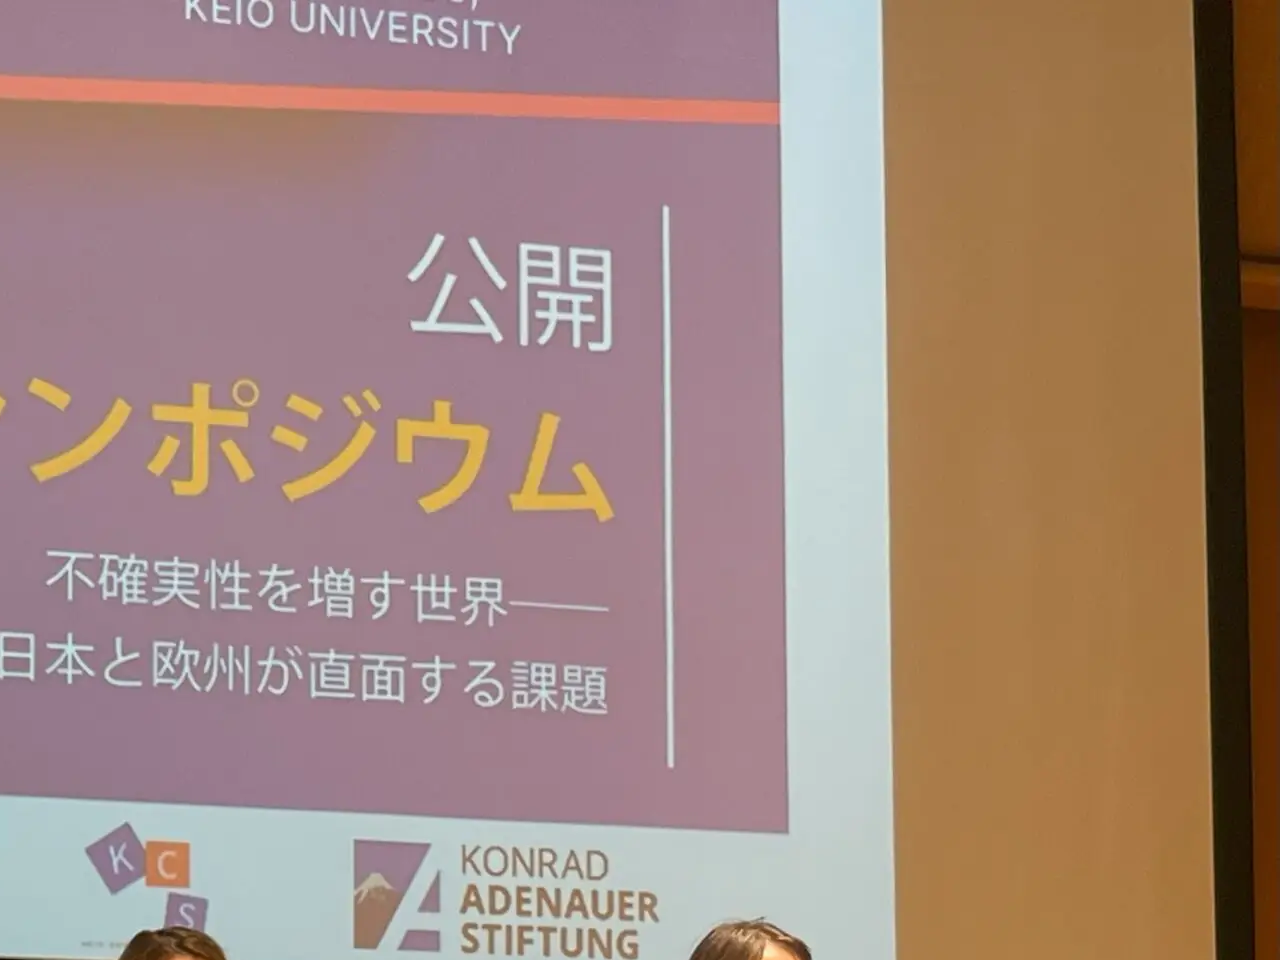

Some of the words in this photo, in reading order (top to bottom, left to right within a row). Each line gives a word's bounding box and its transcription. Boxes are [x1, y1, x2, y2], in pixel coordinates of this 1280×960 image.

[184, 0, 275, 28] KEIO
[290, 0, 522, 54] UNIVERSITY
[406, 231, 614, 352] 公開
[460, 844, 609, 881] KONRAD
[459, 883, 660, 923] ADENAUER
[460, 922, 640, 960] STIFTUNG
